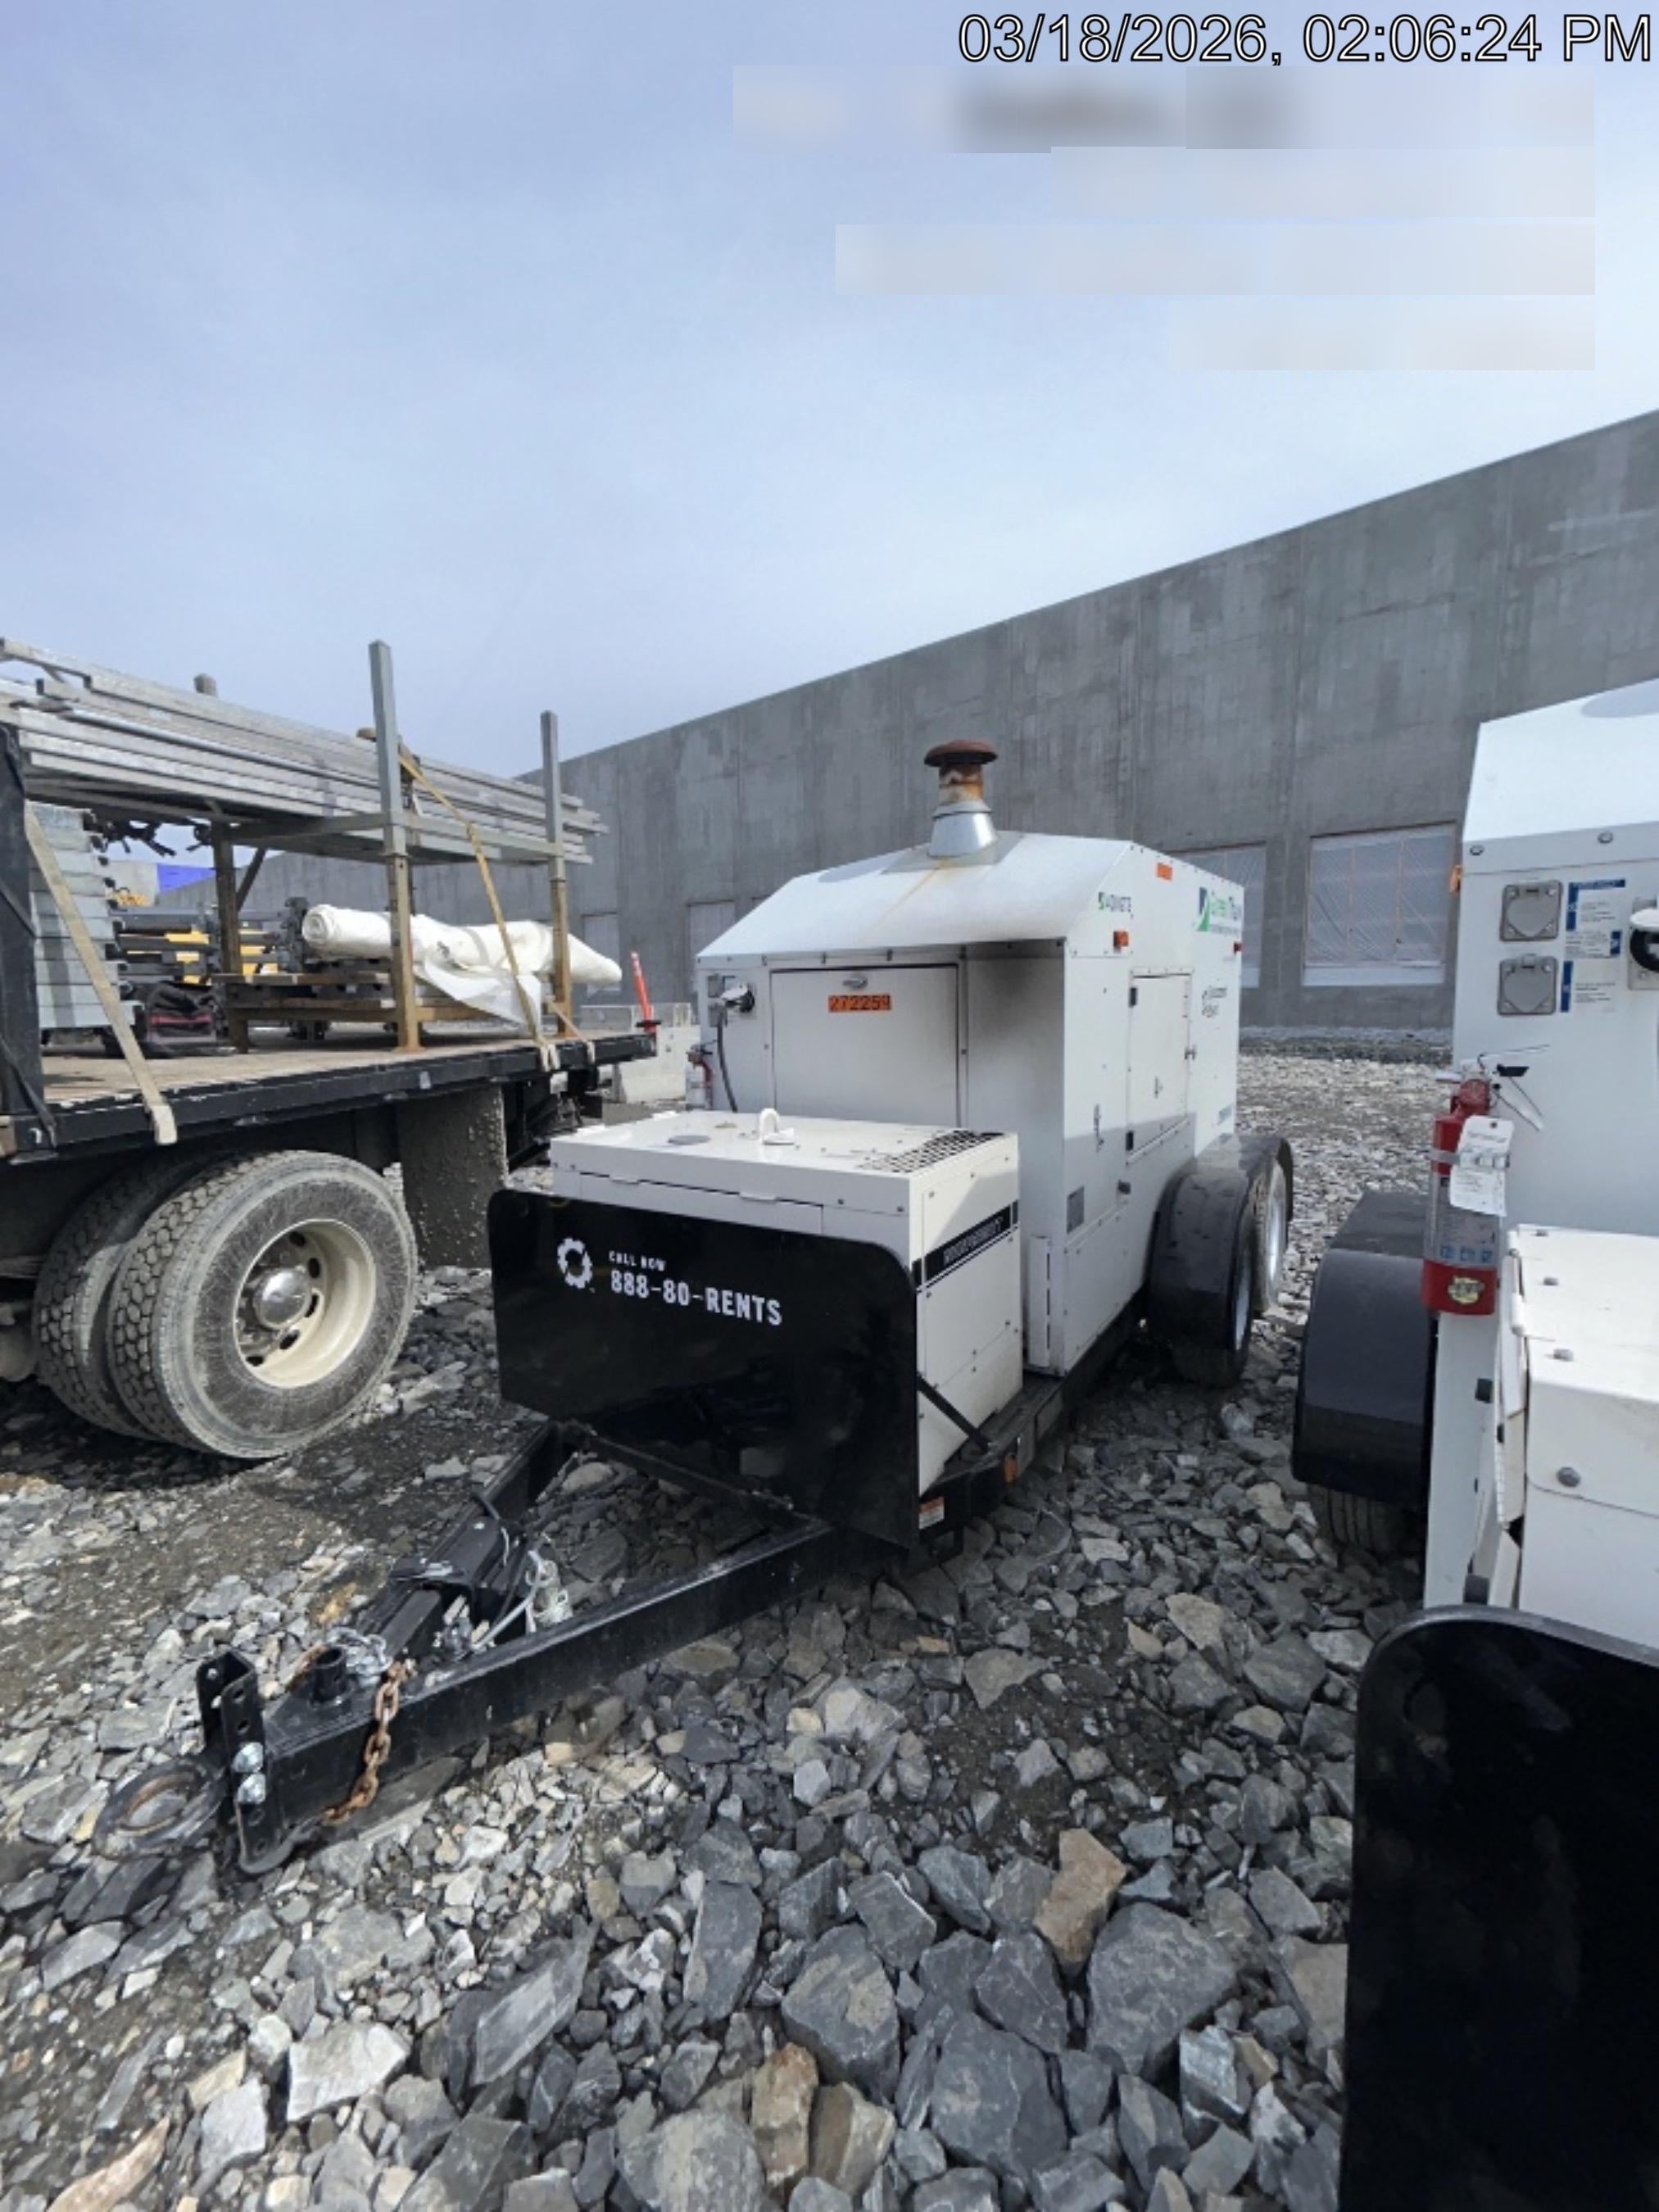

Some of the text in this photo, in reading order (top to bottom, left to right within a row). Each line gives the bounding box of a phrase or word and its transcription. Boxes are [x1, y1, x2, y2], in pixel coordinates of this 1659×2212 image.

[609, 1250, 667, 1271] CALL NOW
[611, 1269, 782, 1326] 888-80-RENTS
